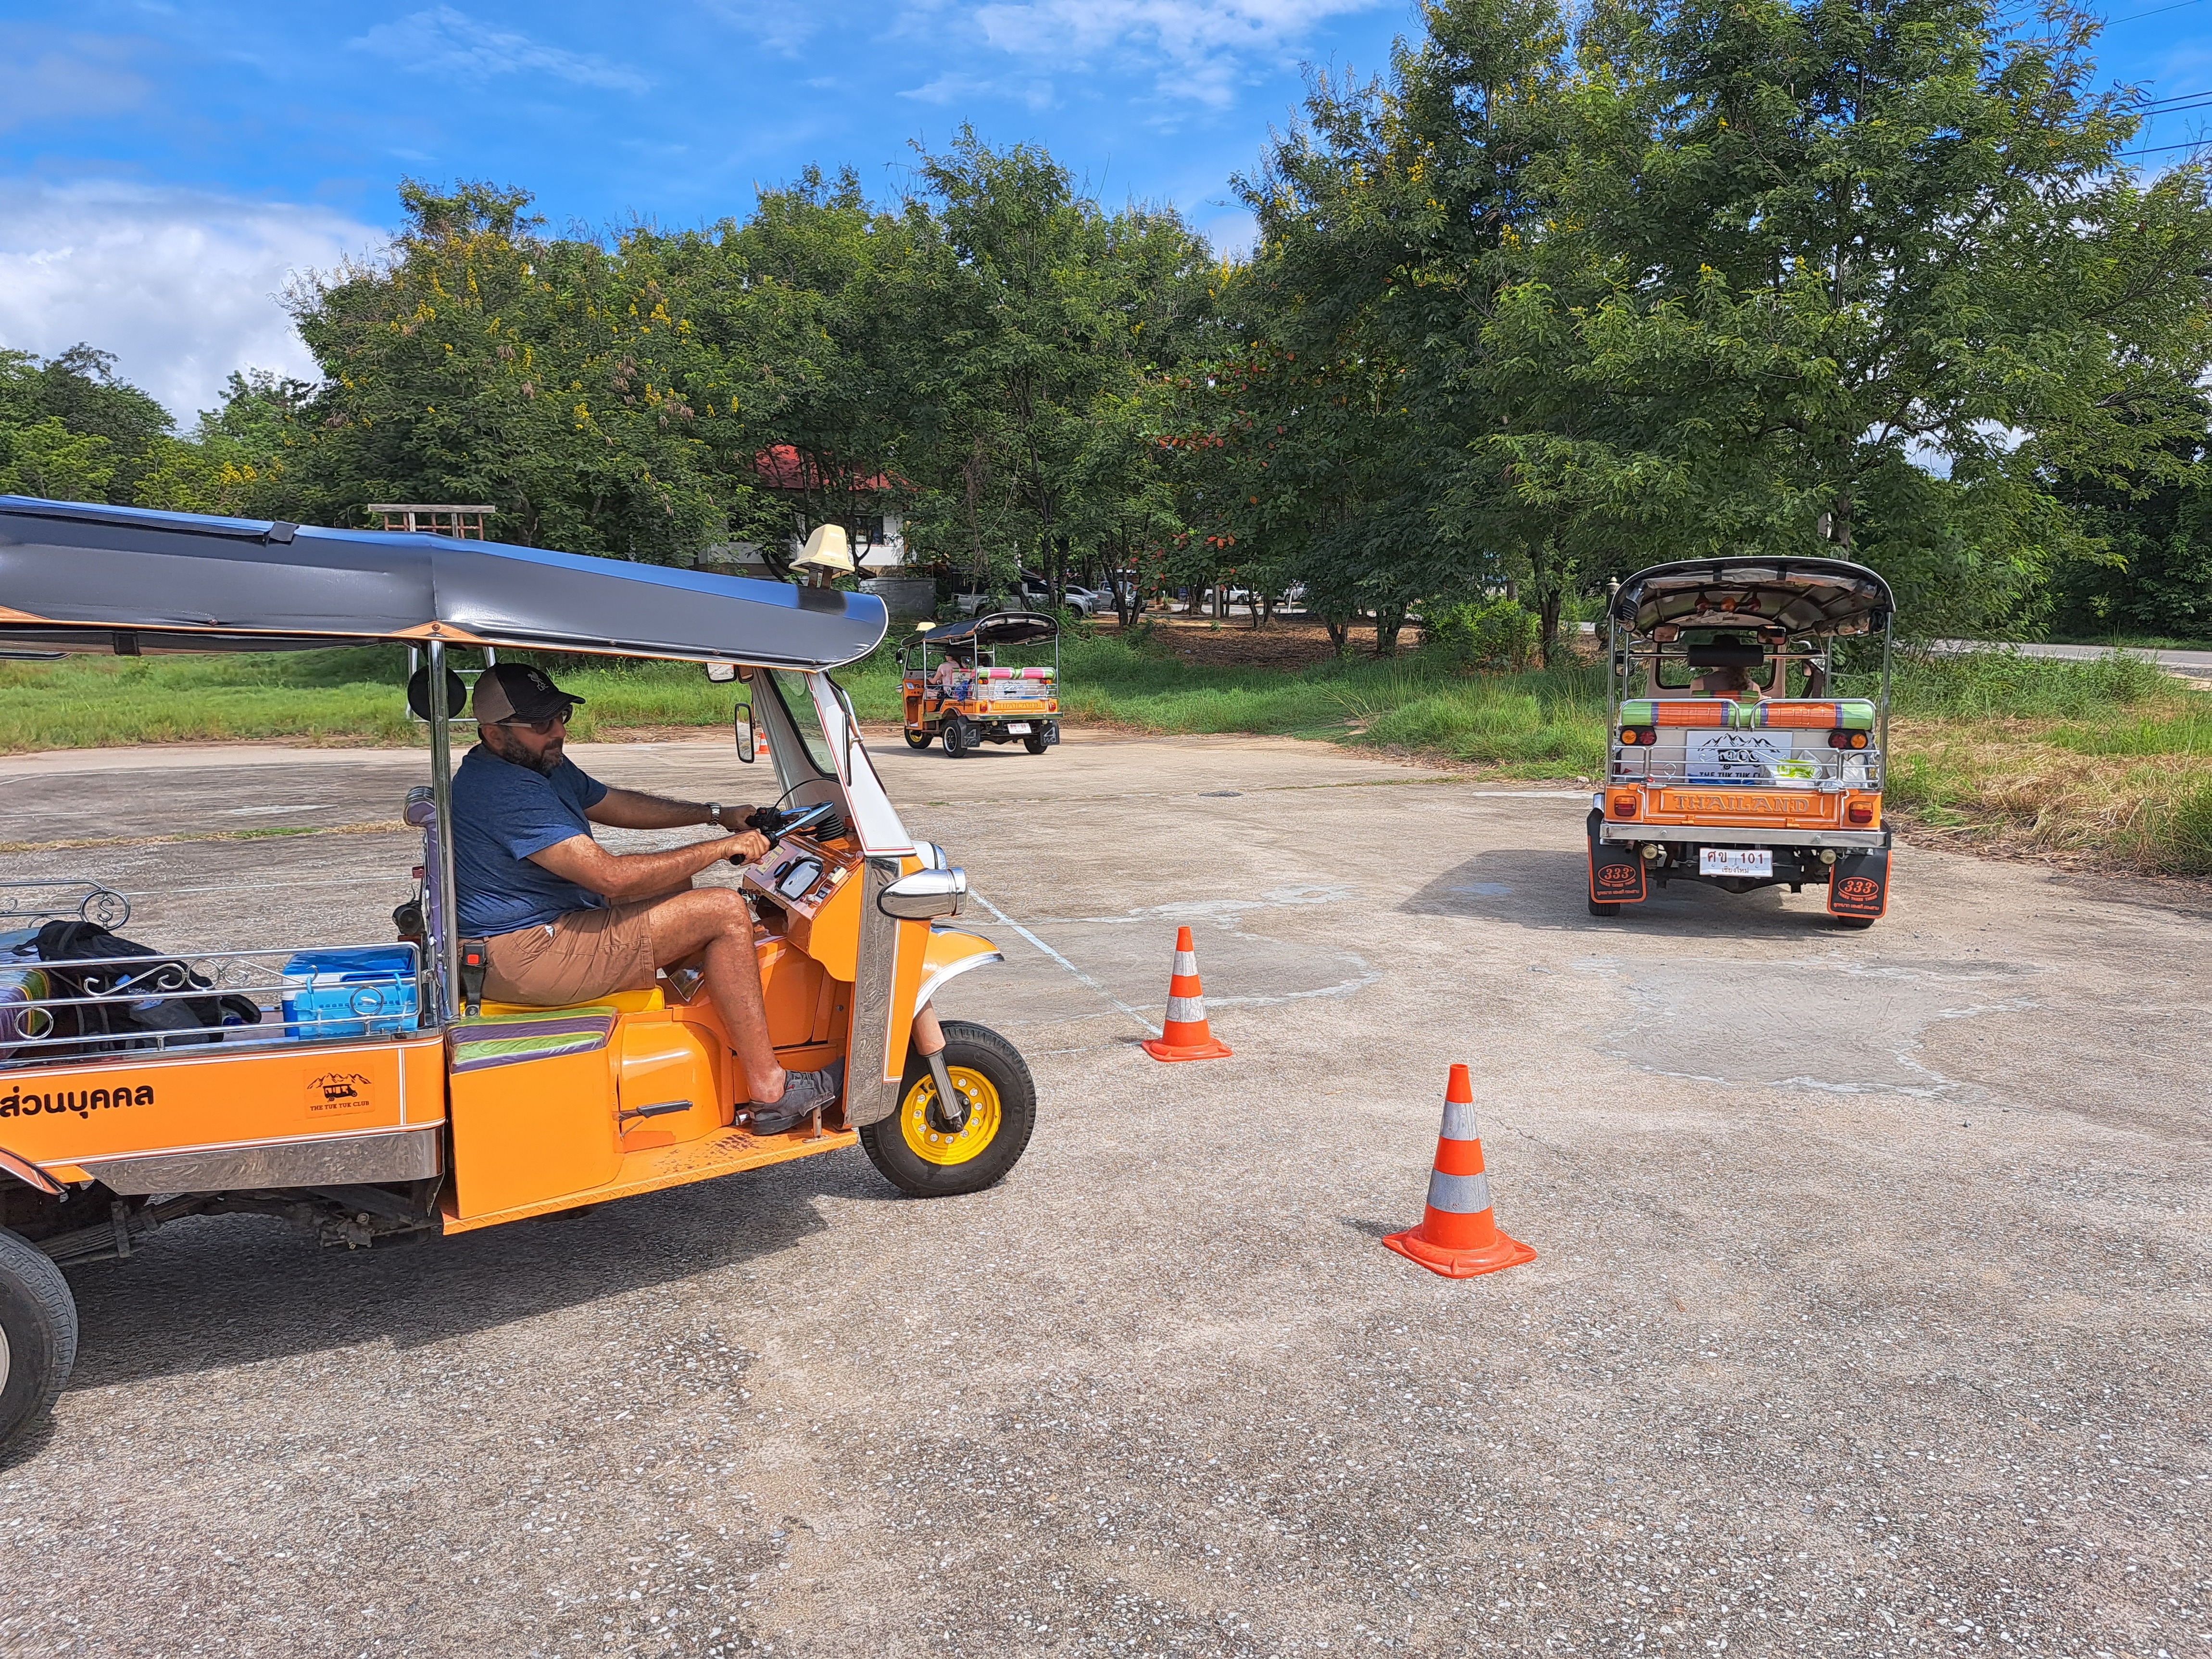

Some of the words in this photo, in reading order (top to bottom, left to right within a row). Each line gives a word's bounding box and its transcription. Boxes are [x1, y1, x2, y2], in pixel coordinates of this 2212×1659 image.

[1674, 795, 1810, 813] THAILAND
[1741, 853, 1763, 864] 101
[1604, 867, 1630, 880] 333
[1844, 880, 1873, 893] 333
[0, 1085, 154, 1119] ส่วนบุคคล
